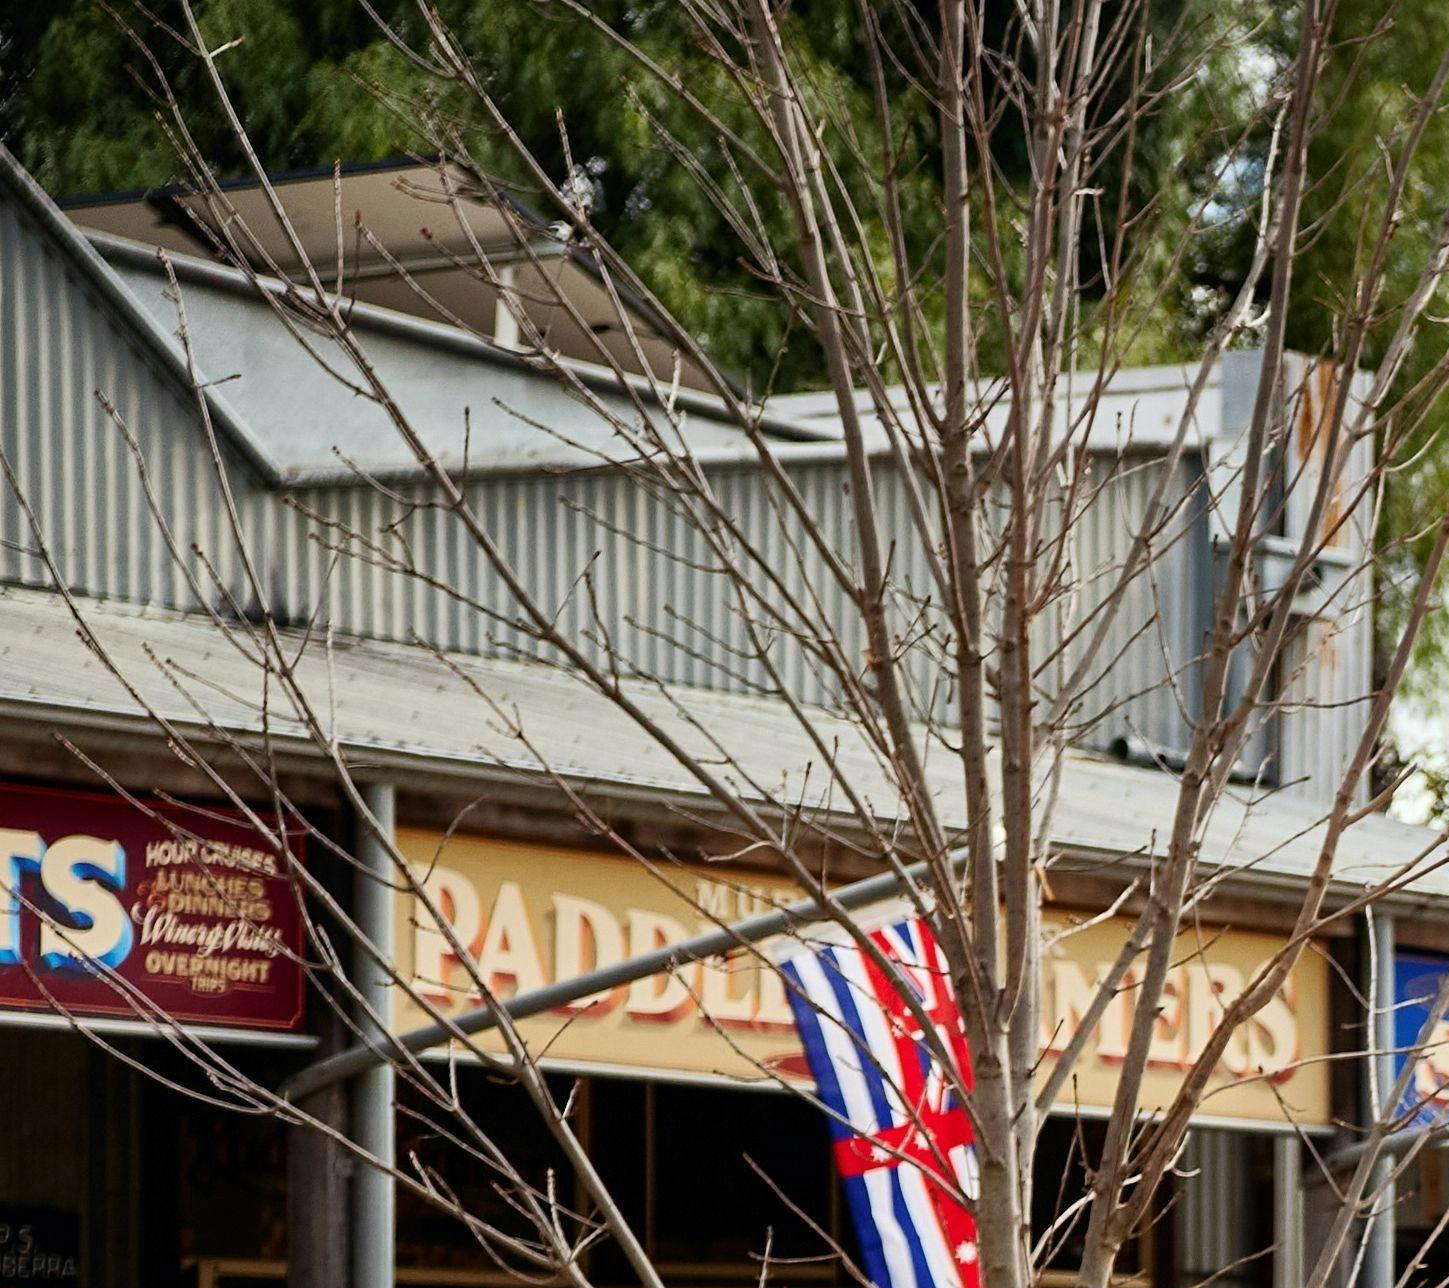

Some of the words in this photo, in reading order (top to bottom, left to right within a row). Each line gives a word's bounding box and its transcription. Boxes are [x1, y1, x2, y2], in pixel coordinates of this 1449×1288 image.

[146, 839, 198, 868] HOUR
[131, 902, 223, 957] Winery
[145, 951, 270, 982] OVERNIGHT
[192, 976, 227, 993] TRIPS
